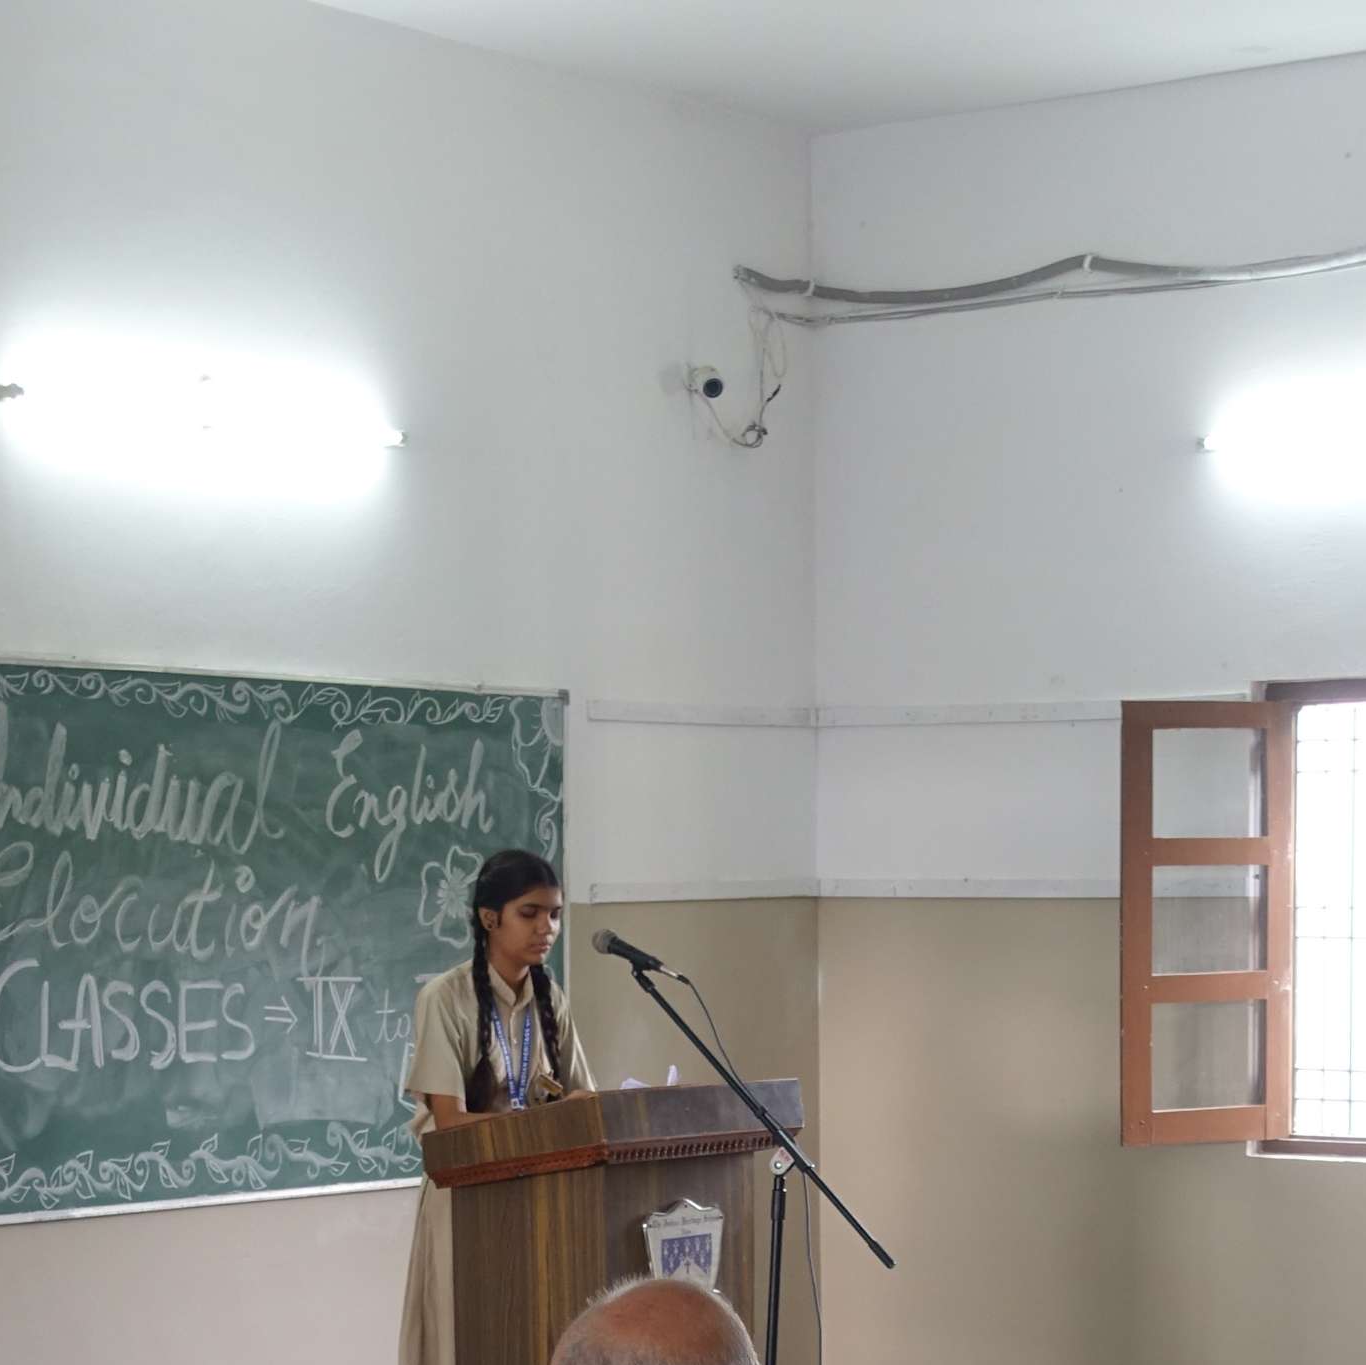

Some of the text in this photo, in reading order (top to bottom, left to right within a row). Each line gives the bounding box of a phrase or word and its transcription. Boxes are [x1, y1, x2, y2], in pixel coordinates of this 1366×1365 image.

[326, 729, 493, 882] English
[296, 976, 368, 1062] IX
[374, 989, 411, 1044] to
